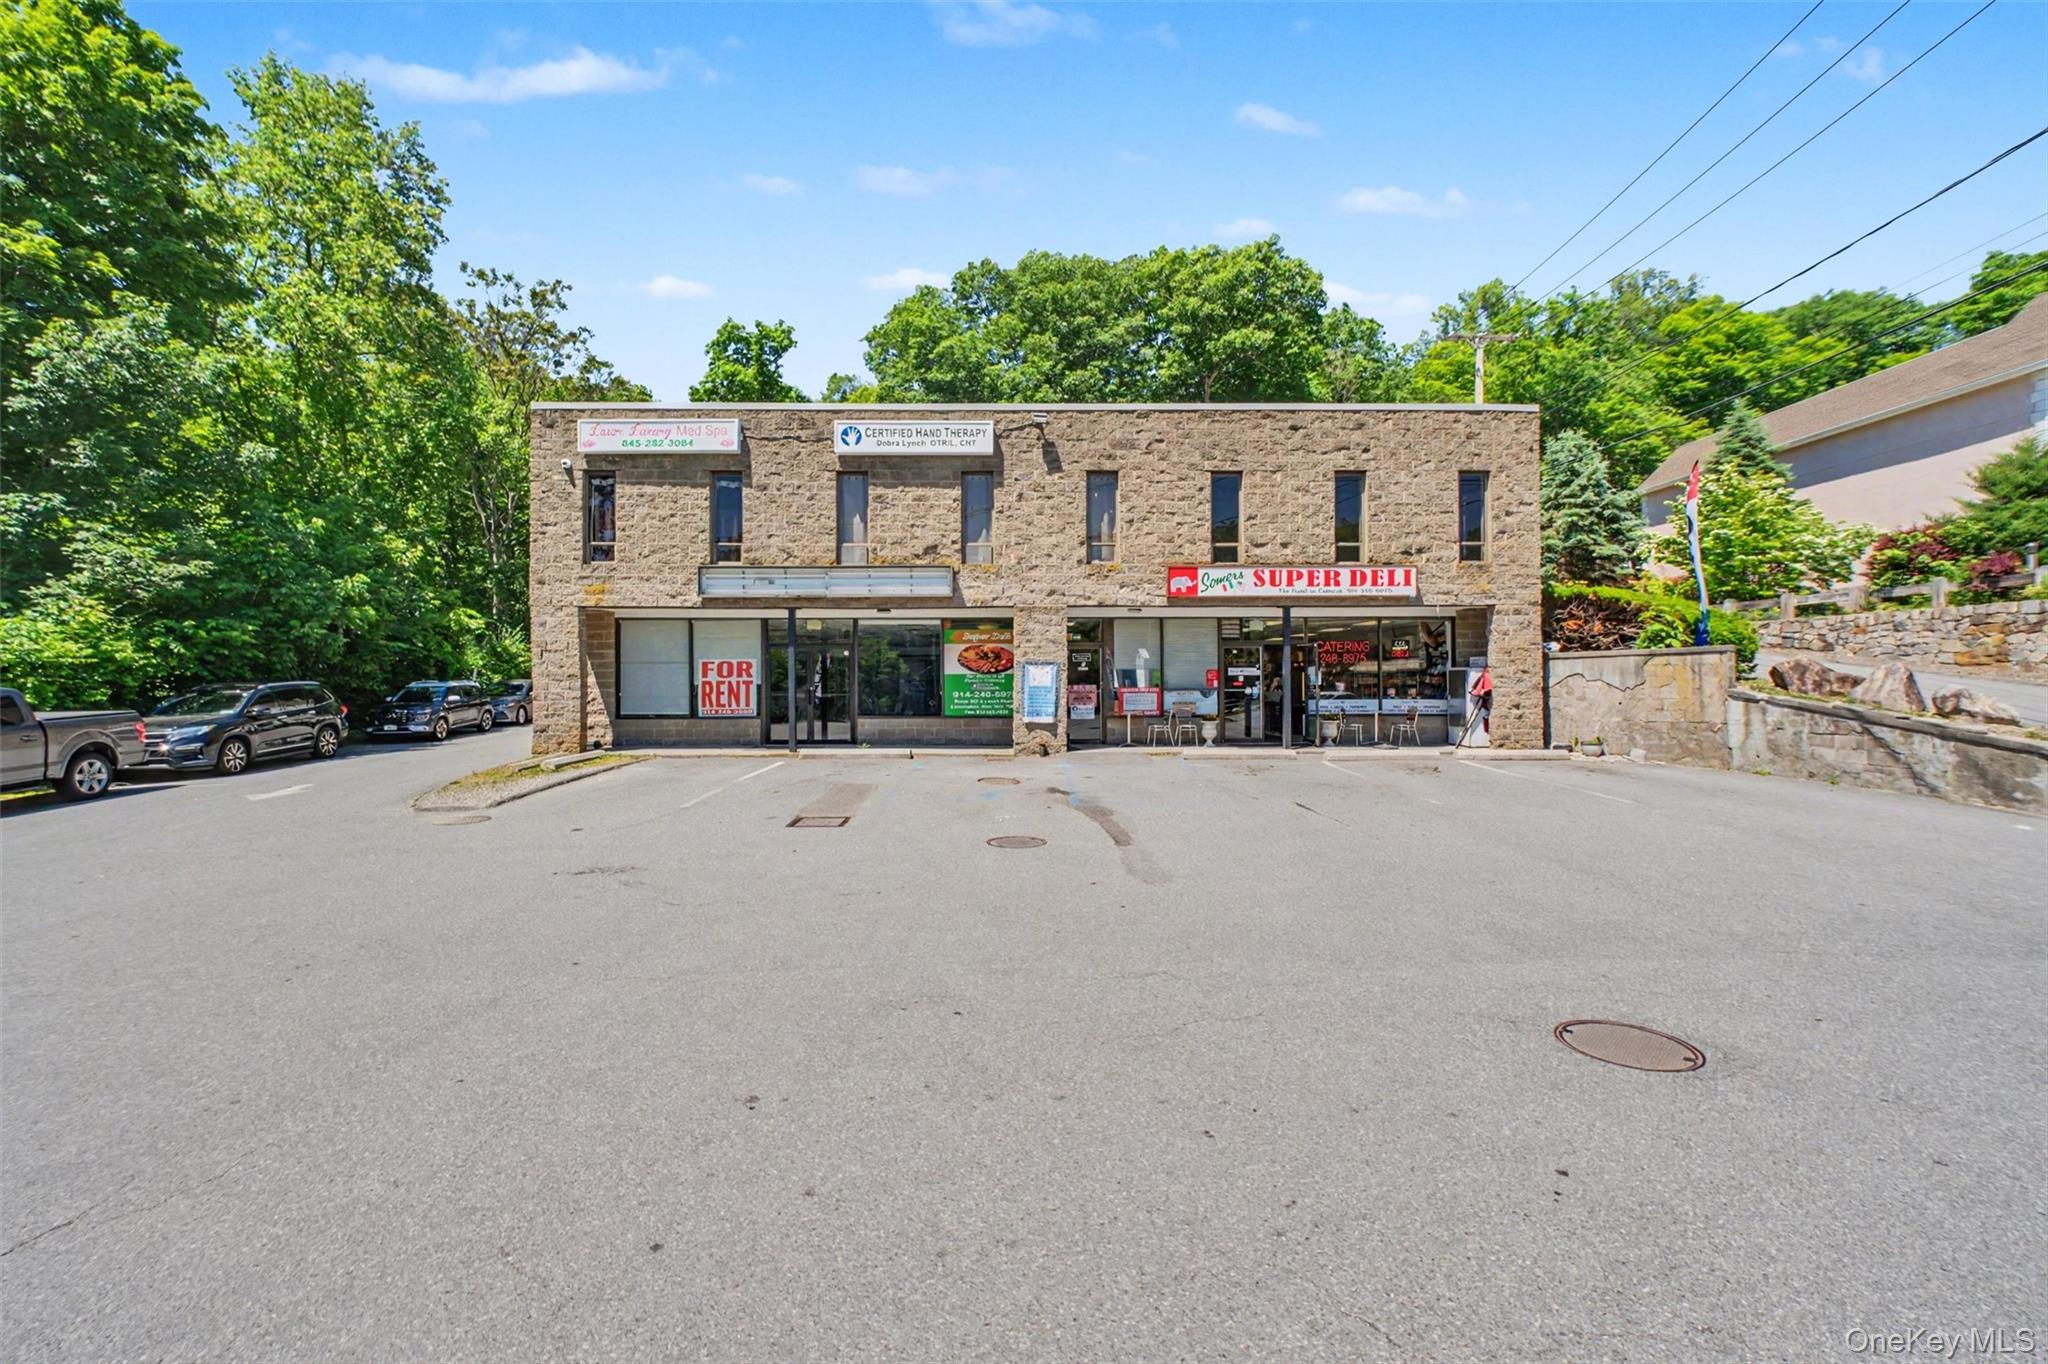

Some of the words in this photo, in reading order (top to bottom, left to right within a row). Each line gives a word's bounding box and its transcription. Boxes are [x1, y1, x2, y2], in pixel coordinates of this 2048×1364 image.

[676, 425, 702, 437] Med
[705, 425, 728, 439] Spa
[864, 427, 913, 438] CERTIFIED
[915, 427, 942, 438] HAND
[944, 427, 987, 438] THERAPY
[621, 439, 641, 448] 845
[644, 439, 664, 448] 282
[667, 439, 694, 448] 3084
[1200, 571, 1244, 593] Somers
[1253, 569, 1341, 588] SUPER
[1350, 569, 1412, 588] DELI
[1315, 640, 1370, 652] CATERING
[1320, 653, 1367, 664] 248-8975
[701, 660, 754, 679] FOR
[701, 680, 754, 708] RENT
